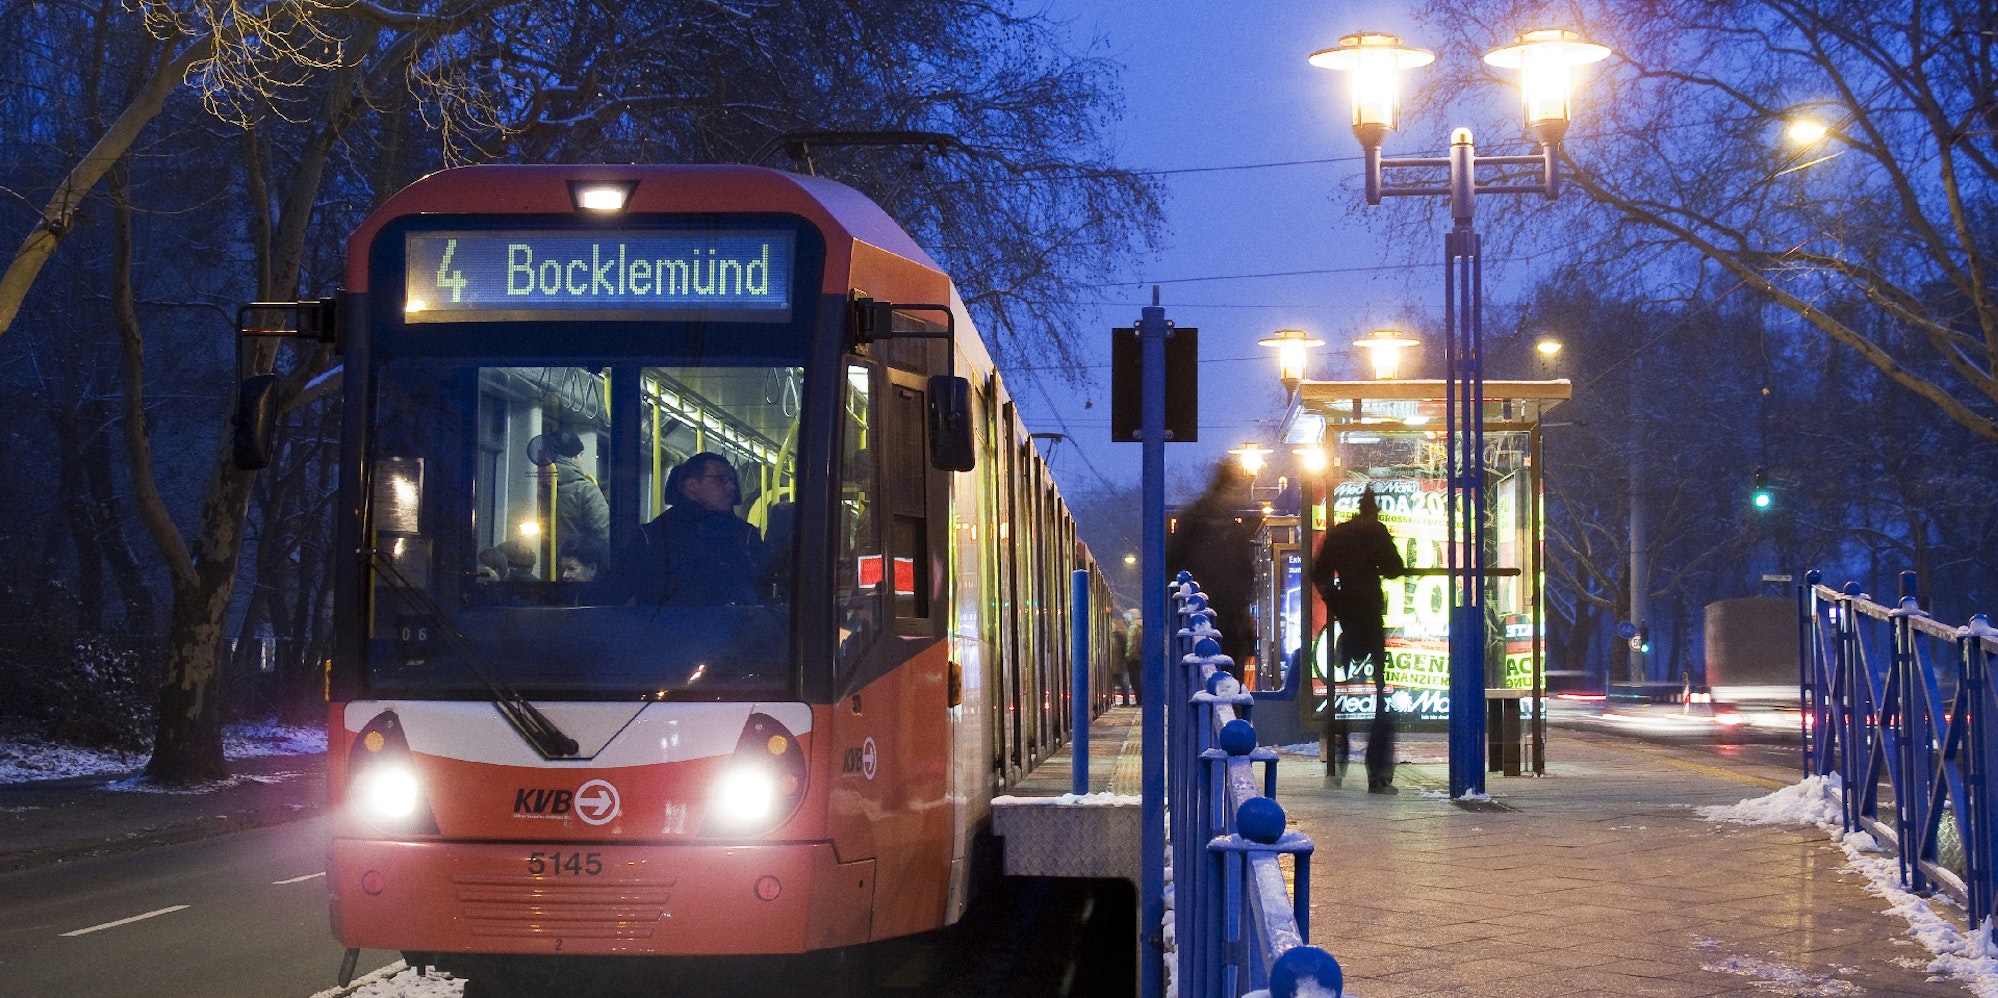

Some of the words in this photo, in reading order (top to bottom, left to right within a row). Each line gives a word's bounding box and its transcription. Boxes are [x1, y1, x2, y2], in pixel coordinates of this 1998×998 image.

[437, 239, 467, 303] 4
[507, 244, 769, 296] Bocklemünd
[1334, 482, 1368, 496] Med
[1382, 481, 1418, 494] Markt
[1384, 651, 1450, 673] AGEN
[513, 788, 574, 815] KVB
[528, 852, 603, 876] 5145
[555, 938, 563, 951] 2
